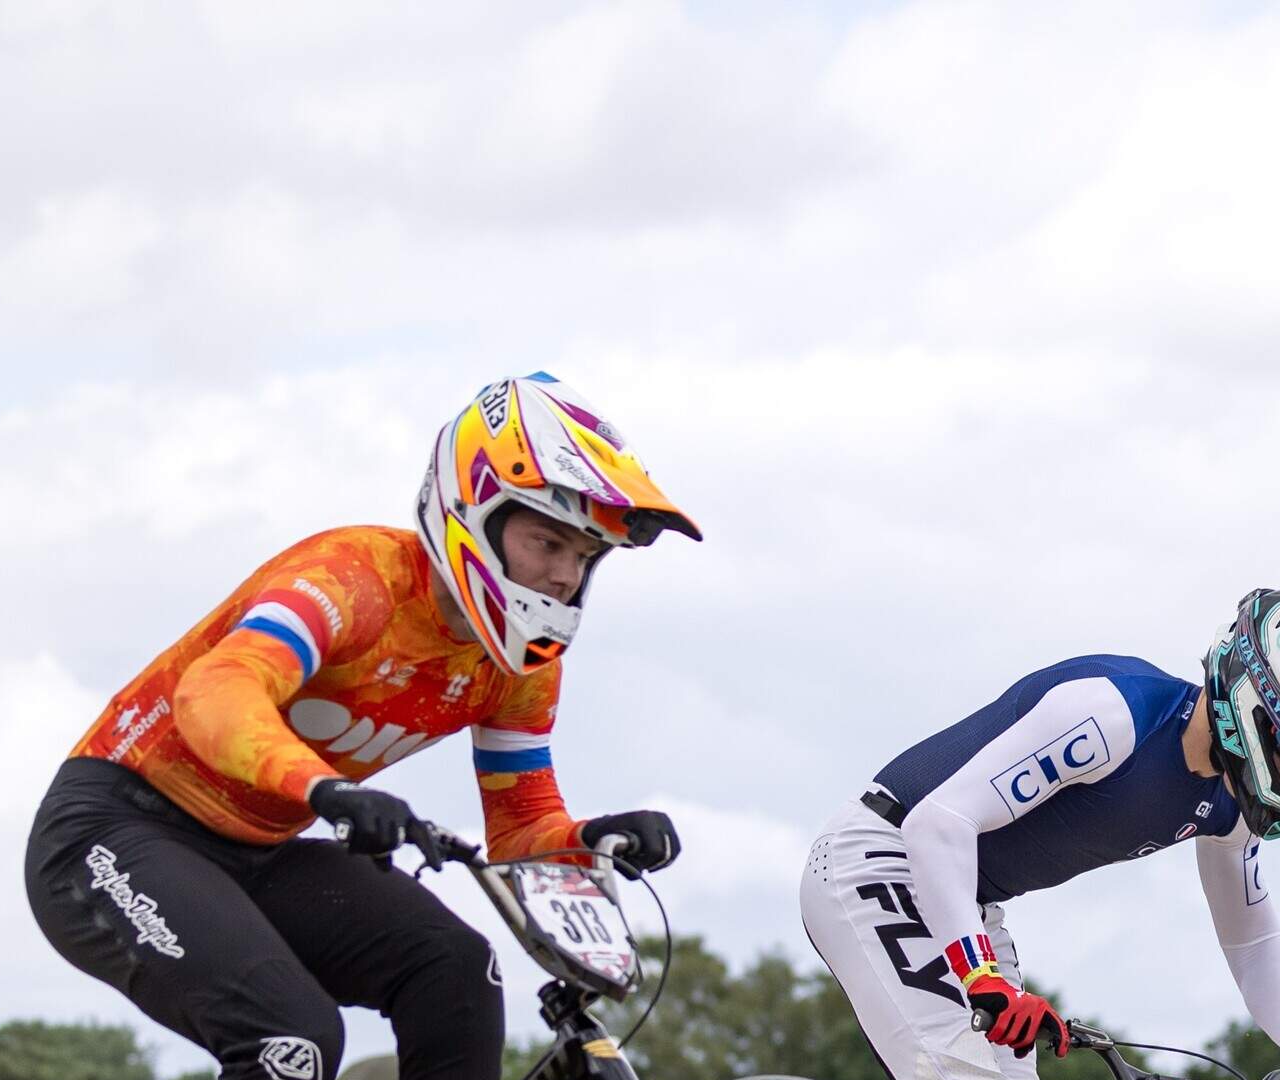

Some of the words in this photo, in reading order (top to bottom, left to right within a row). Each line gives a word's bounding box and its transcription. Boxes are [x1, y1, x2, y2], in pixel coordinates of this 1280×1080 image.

[292, 577, 345, 638] TeamNL
[1213, 700, 1246, 759] FLY
[1010, 733, 1096, 804] CIC
[548, 899, 614, 945] 313
[854, 880, 968, 1009] FLY
